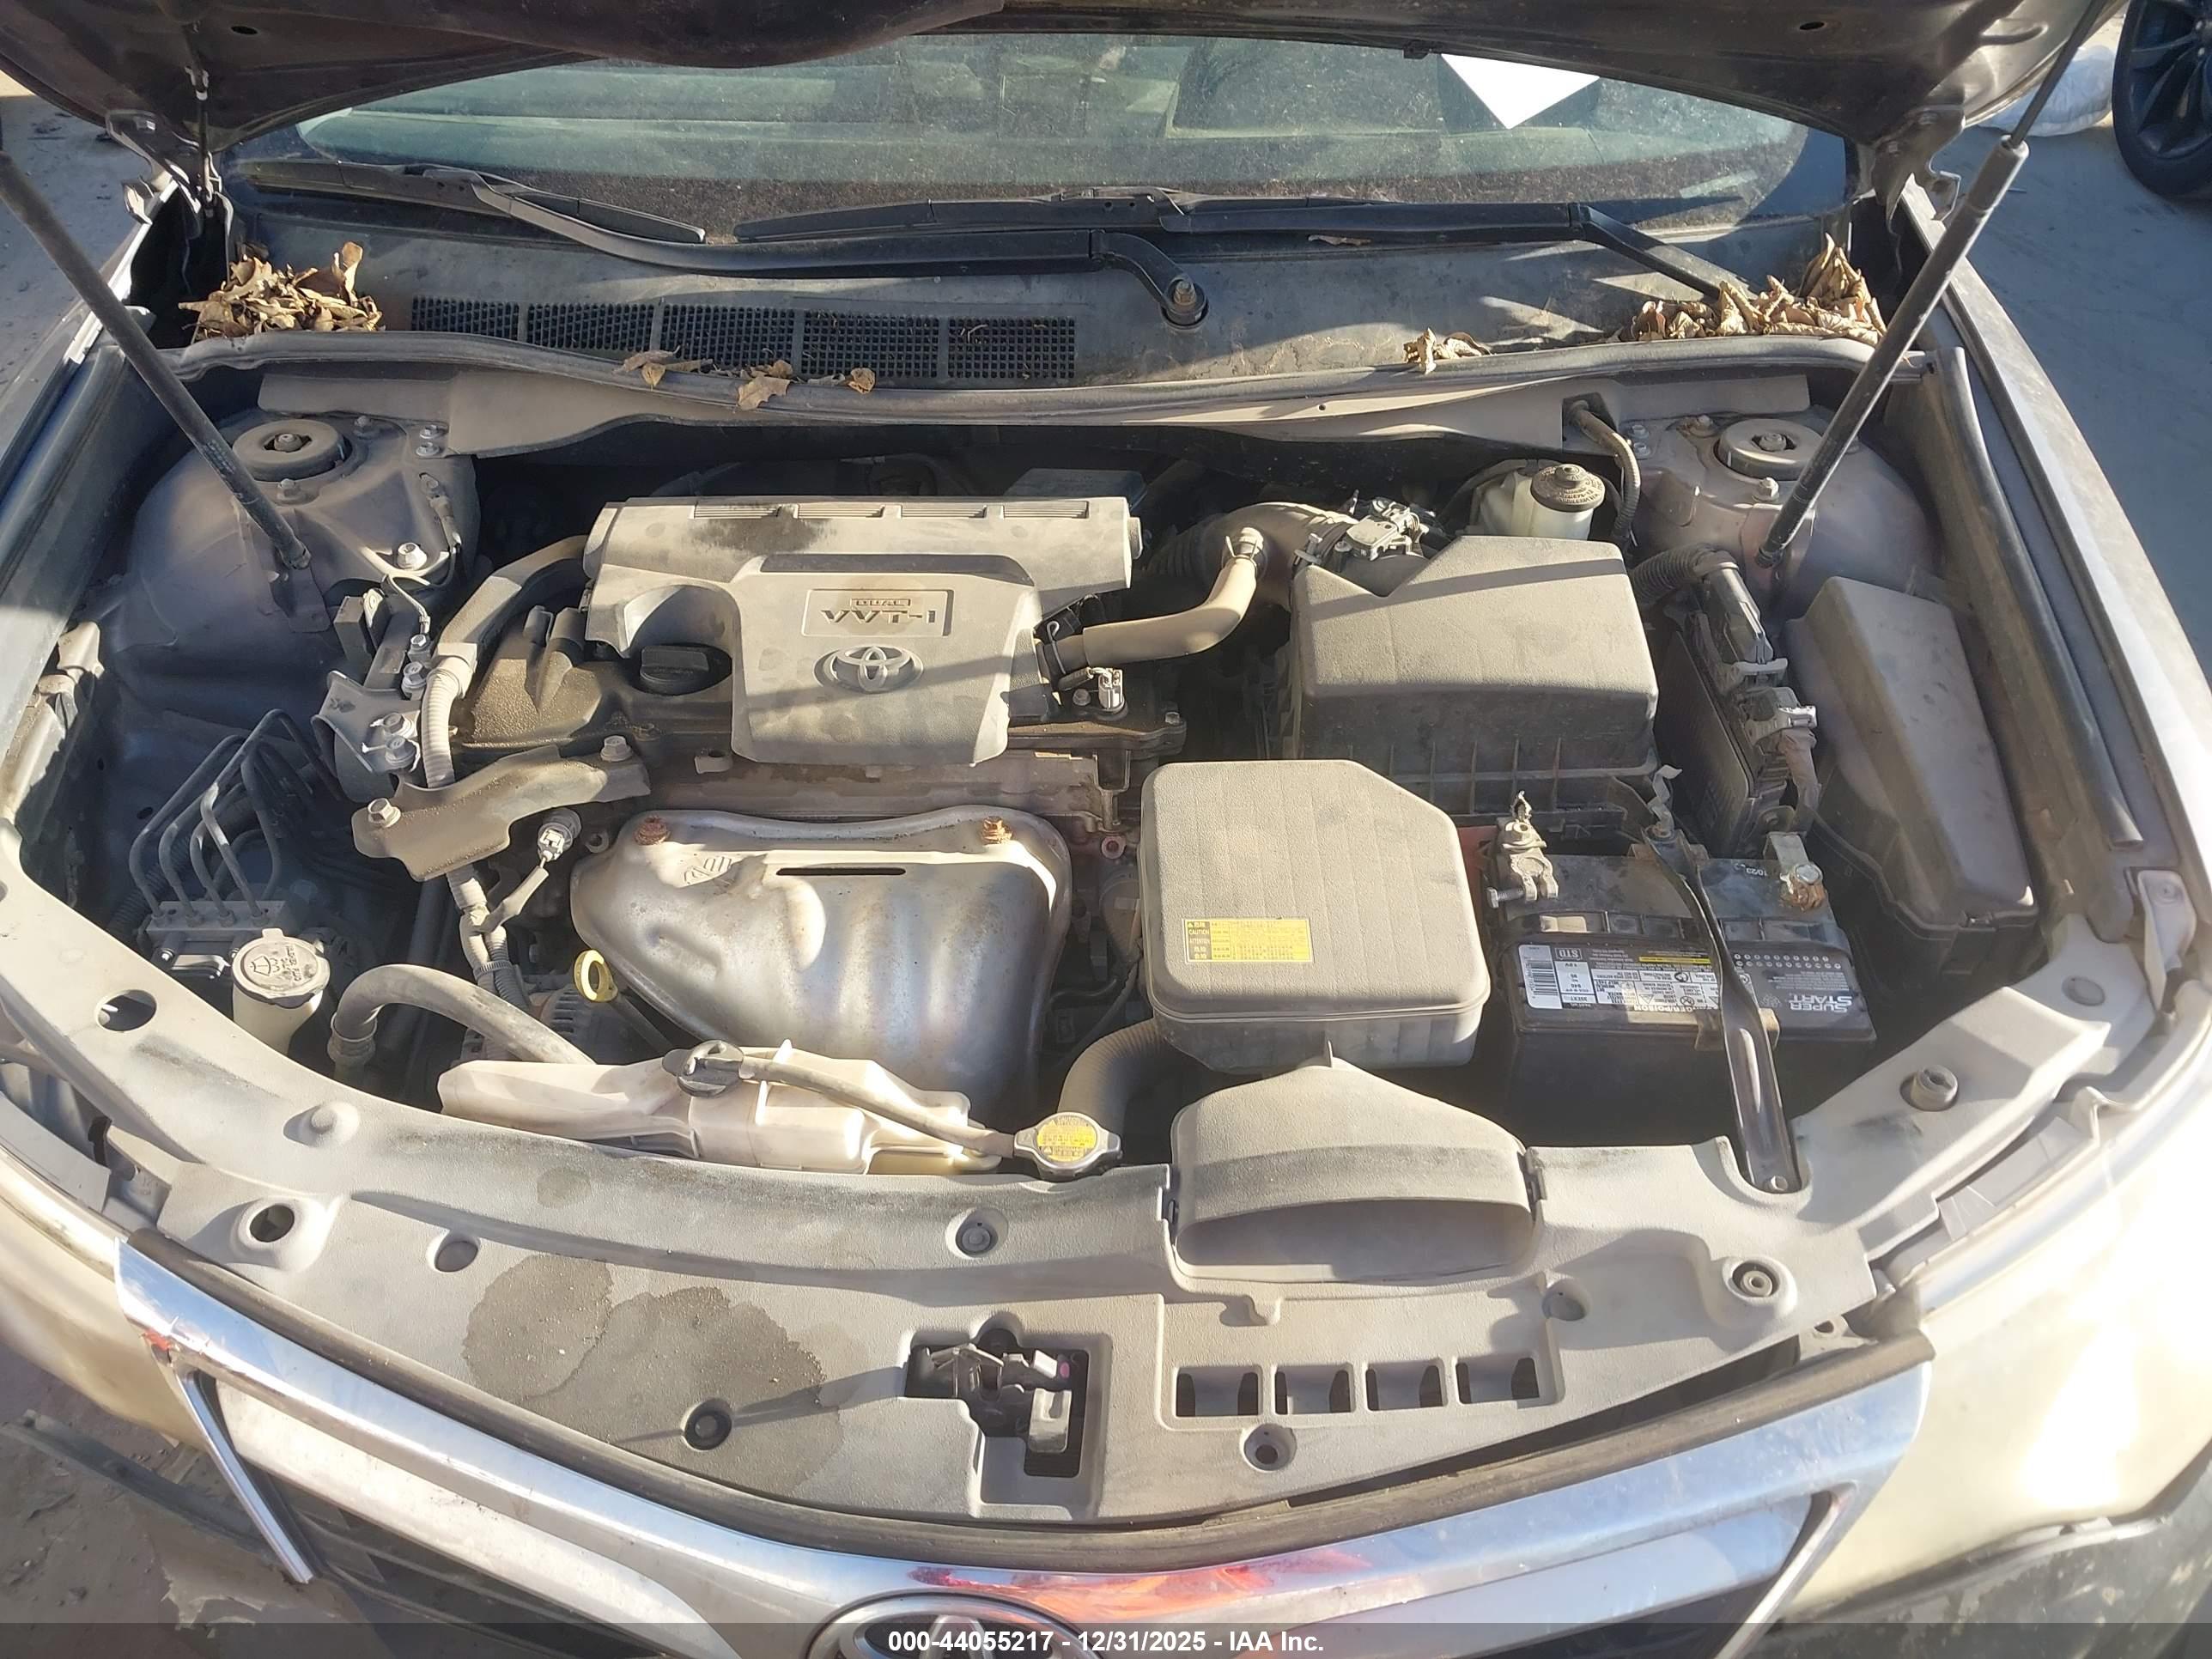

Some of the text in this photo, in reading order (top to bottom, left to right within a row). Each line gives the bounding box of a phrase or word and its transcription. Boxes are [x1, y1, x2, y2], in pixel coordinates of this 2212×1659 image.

[854, 598, 910, 606] DUAL
[1559, 949, 1579, 958] STD
[1788, 995, 1852, 1006] START
[1790, 1001, 1848, 1012] SUPER
